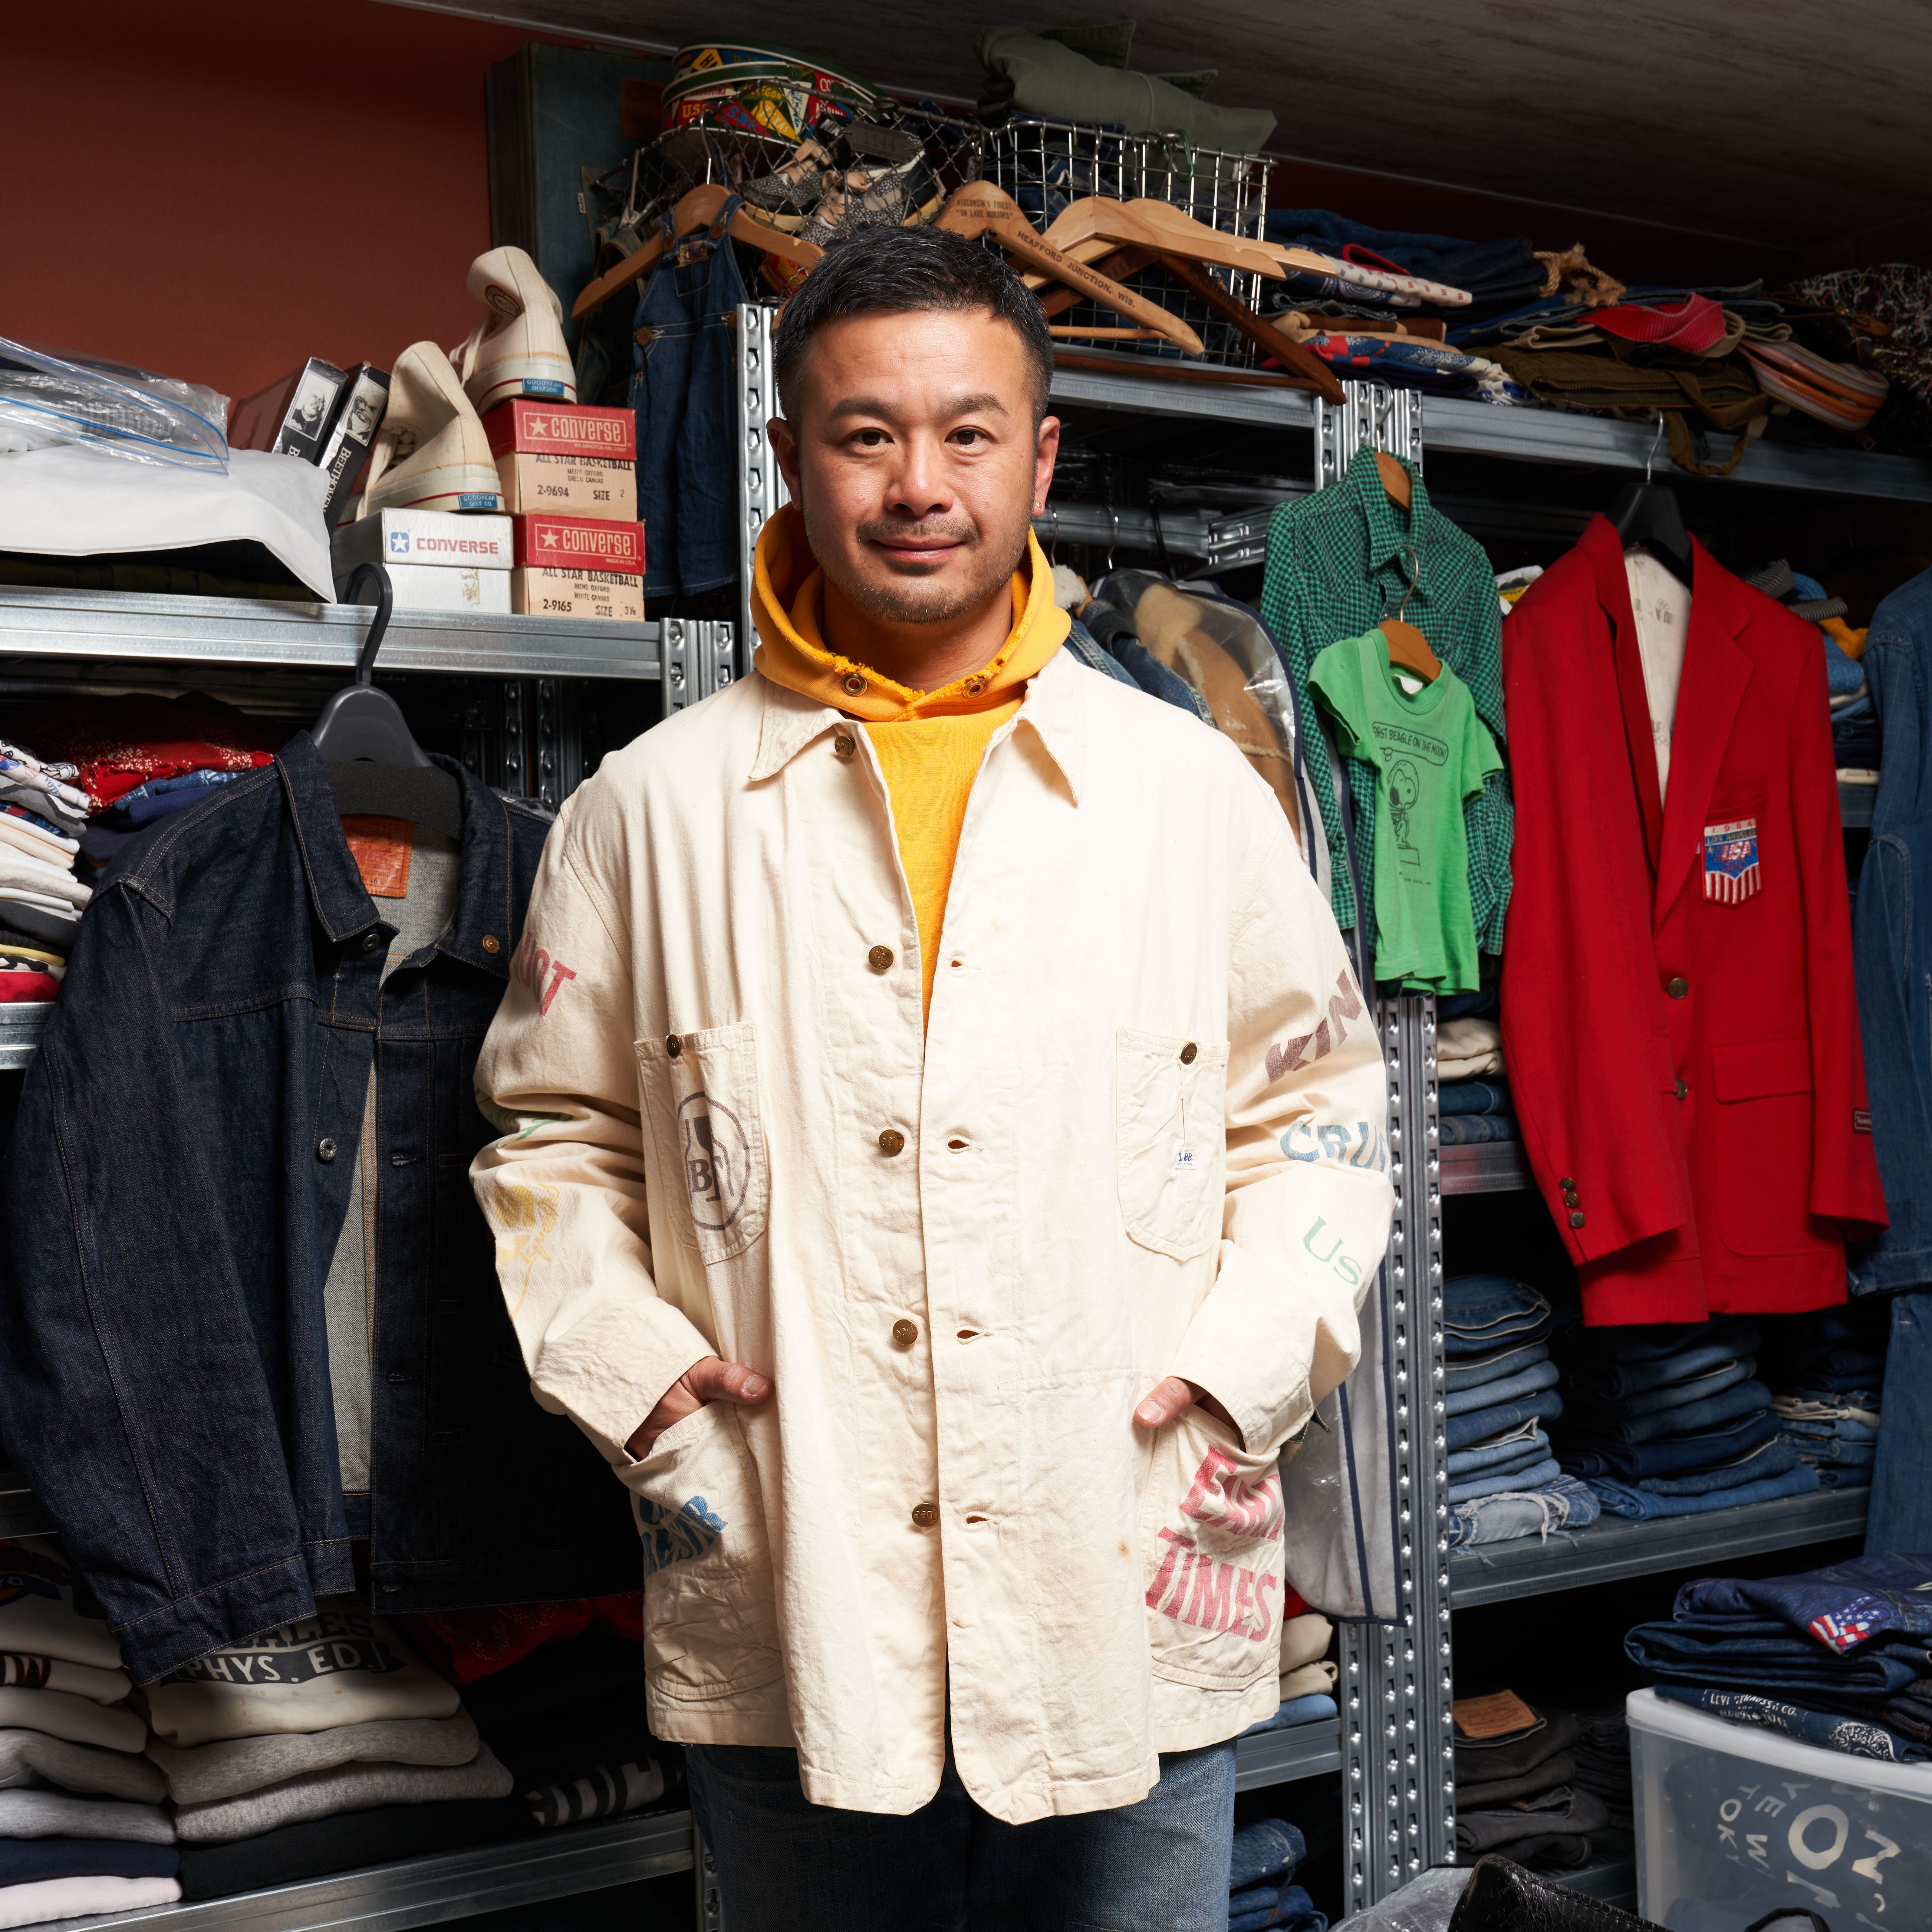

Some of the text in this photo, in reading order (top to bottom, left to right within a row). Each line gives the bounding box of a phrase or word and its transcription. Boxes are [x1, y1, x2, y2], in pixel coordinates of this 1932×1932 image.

[994, 201, 1011, 210] FINEST
[970, 210, 984, 218] LAKE
[1017, 230, 1062, 263] HEAFFORD
[1067, 262, 1112, 294] JUNCTION,
[1118, 292, 1135, 307] WIS.
[536, 454, 632, 471] ALL STAR BASKETBALL
[537, 485, 625, 501] 2-9694 SIZE 2
[542, 567, 638, 588] ALL STAR BASKETBALL
[591, 585, 610, 593] OXFORD
[592, 594, 610, 602] CANVAS
[543, 599, 572, 612] 2-9165
[595, 605, 613, 617] SIZE
[1372, 726, 1446, 760] FIRST BEAGLE ON THE MOON!
[1707, 835, 1723, 844] LOS
[1721, 840, 1752, 860] USA
[881, 1136, 903, 1146] Lee
[1179, 1152, 1192, 1161] Lee
[894, 1324, 916, 1339] Lee
[914, 1510, 936, 1521] Lee
[1145, 1526, 1277, 1642] TIMES
[178, 1643, 375, 1683] PHYS. ED.
[1781, 1705, 1796, 1716] CO.
